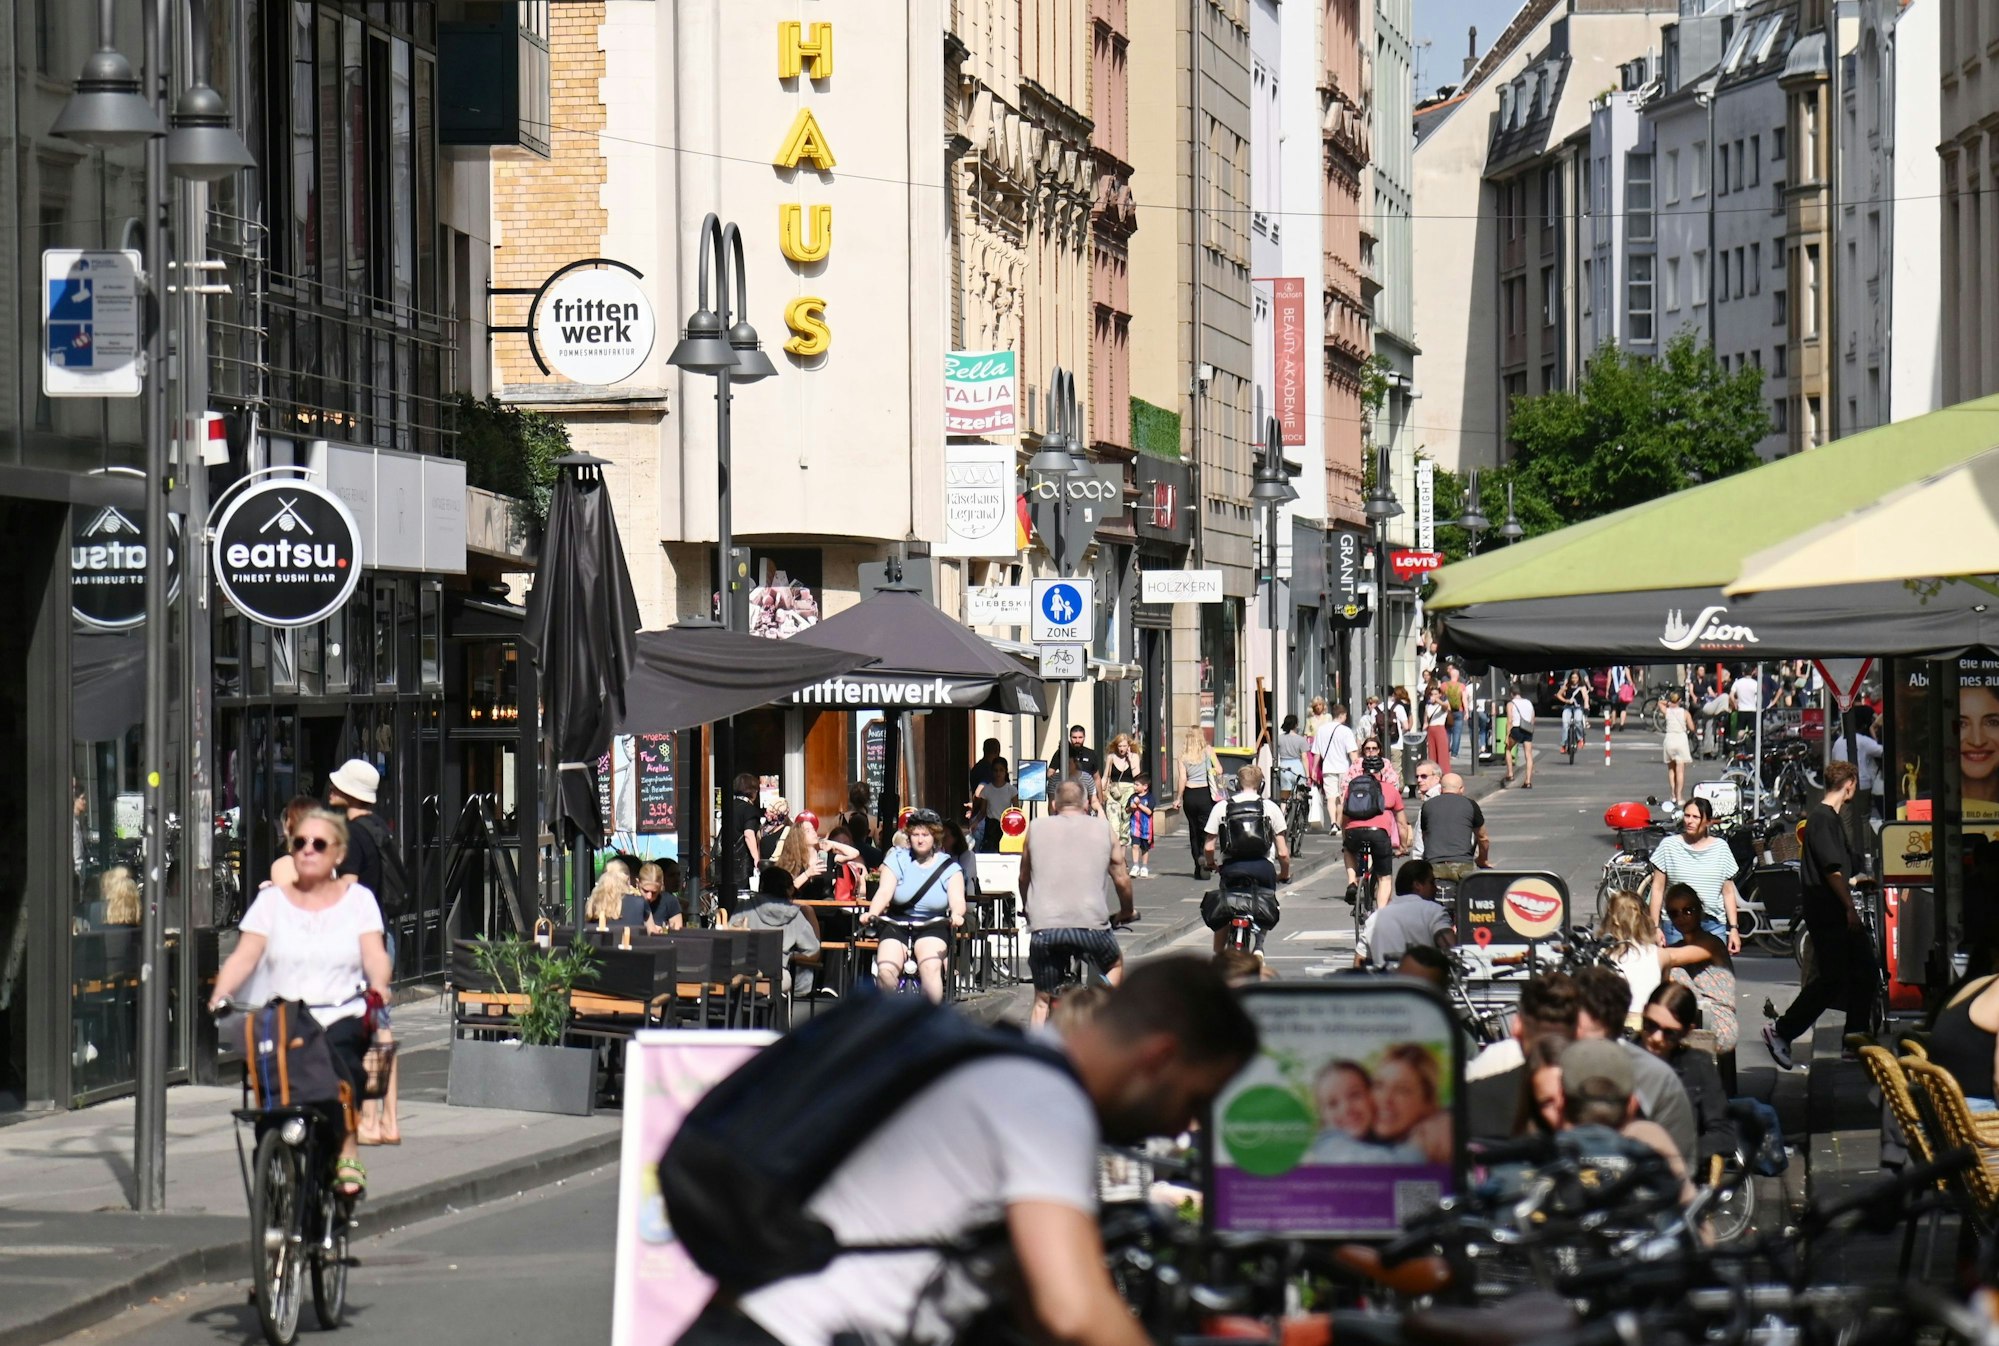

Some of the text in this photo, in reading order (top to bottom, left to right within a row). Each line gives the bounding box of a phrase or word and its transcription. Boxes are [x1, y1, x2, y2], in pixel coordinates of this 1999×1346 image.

[772, 21, 837, 356] HAUS
[553, 298, 639, 322] fritten
[561, 316, 632, 344] werk
[559, 348, 635, 357] POMMESMANUFAKTUR
[945, 358, 1009, 379] Bella
[1283, 307, 1296, 428] BEAUTY-AKADEMIE
[945, 385, 1011, 403] TALIA
[945, 410, 1014, 430] izzeria
[950, 507, 996, 522] Legrand
[226, 539, 347, 569] eatsu.
[1340, 534, 1354, 597] GRANIT
[232, 573, 336, 583] FINEST SUSHI BAR
[1147, 581, 1216, 593] HOLZKERN
[1047, 627, 1078, 638] ZONE
[1055, 666, 1069, 674] frei
[1475, 900, 1495, 909] was
[1469, 911, 1496, 922] here!
